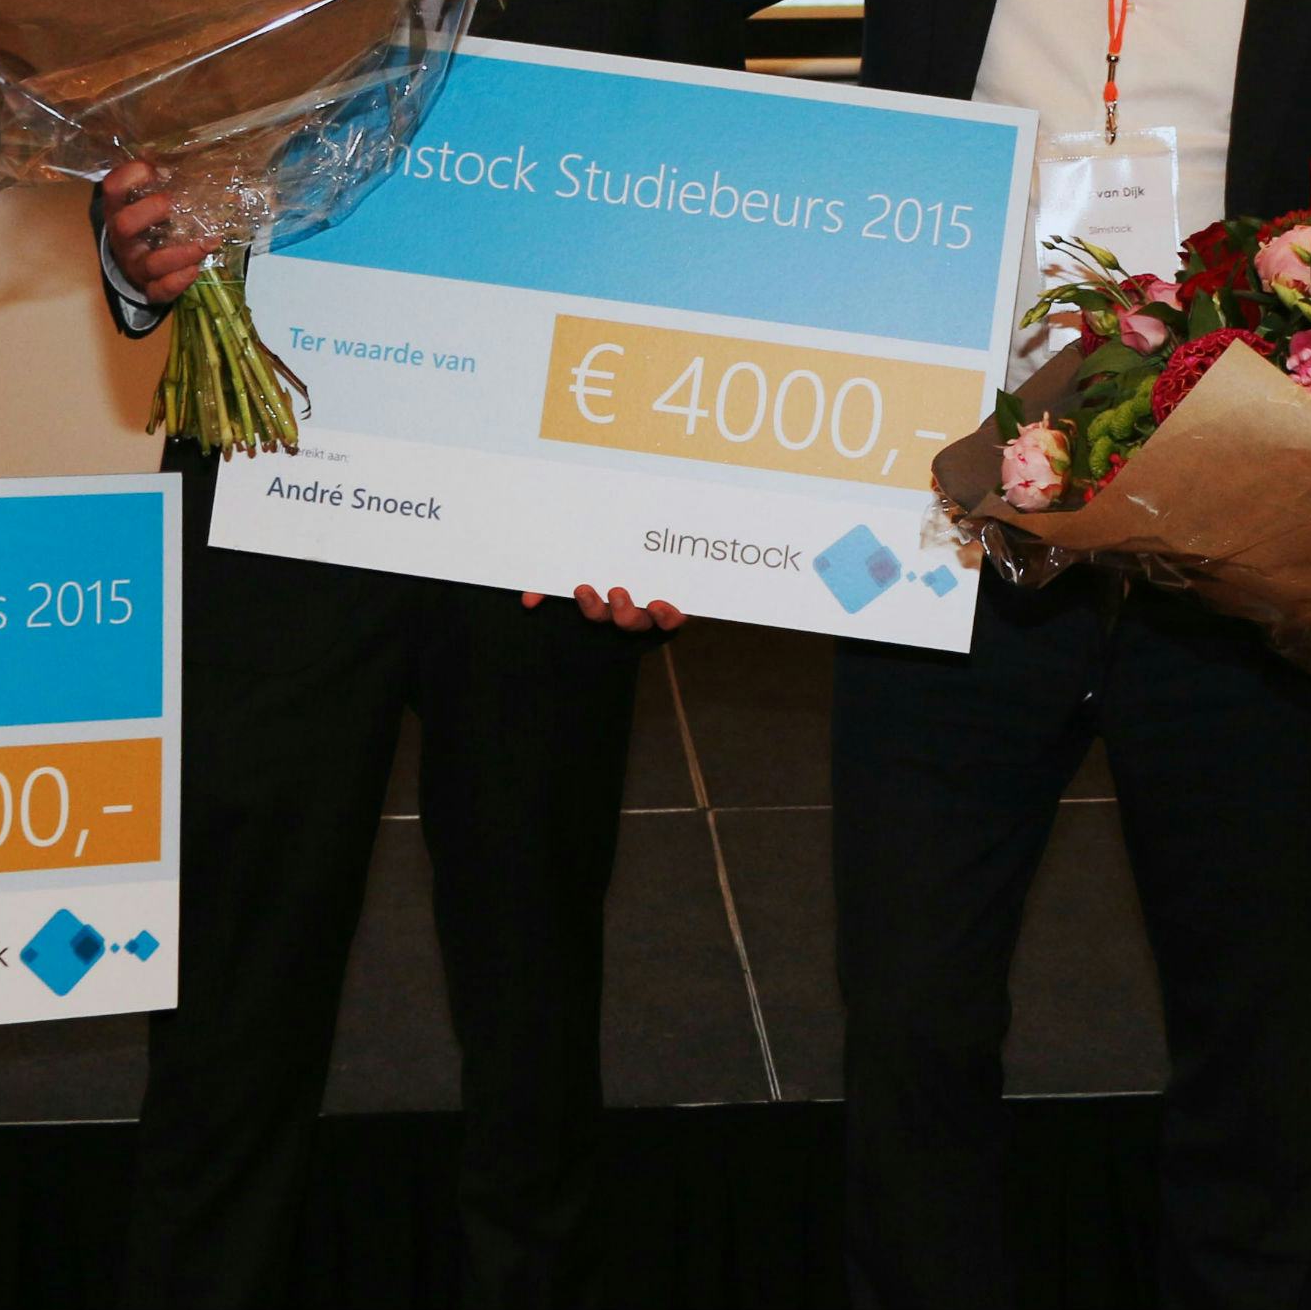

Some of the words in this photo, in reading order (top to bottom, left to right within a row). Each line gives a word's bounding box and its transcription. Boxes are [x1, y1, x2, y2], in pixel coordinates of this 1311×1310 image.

[555, 153, 845, 233] Studiebeurs
[861, 194, 974, 250] 2015
[1097, 188, 1119, 198] van
[1123, 187, 1145, 199] Dijk
[289, 327, 326, 352] Ter
[334, 339, 424, 367] waarde
[433, 353, 476, 373] van
[569, 343, 625, 424] €
[653, 357, 947, 476] 4000,-
[266, 476, 343, 507] André
[351, 488, 442, 521] Snoeck
[643, 528, 802, 571] slimstock
[26, 579, 134, 628] 2015
